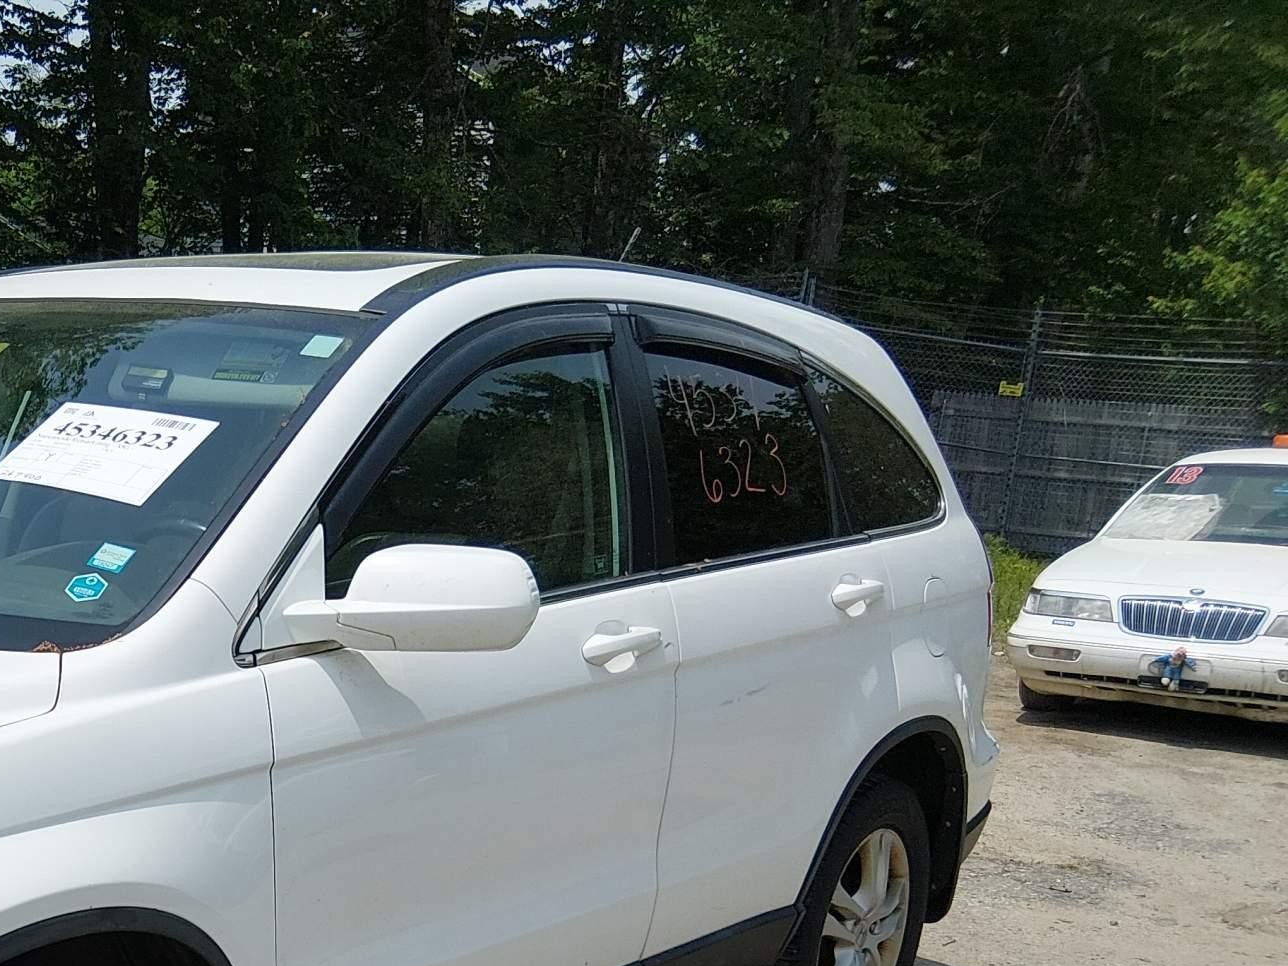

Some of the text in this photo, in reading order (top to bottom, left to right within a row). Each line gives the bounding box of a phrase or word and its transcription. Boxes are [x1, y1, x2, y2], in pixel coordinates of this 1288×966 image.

[52, 420, 179, 451] 45346323
[698, 432, 788, 503] 6323
[1165, 465, 1205, 485] 13
